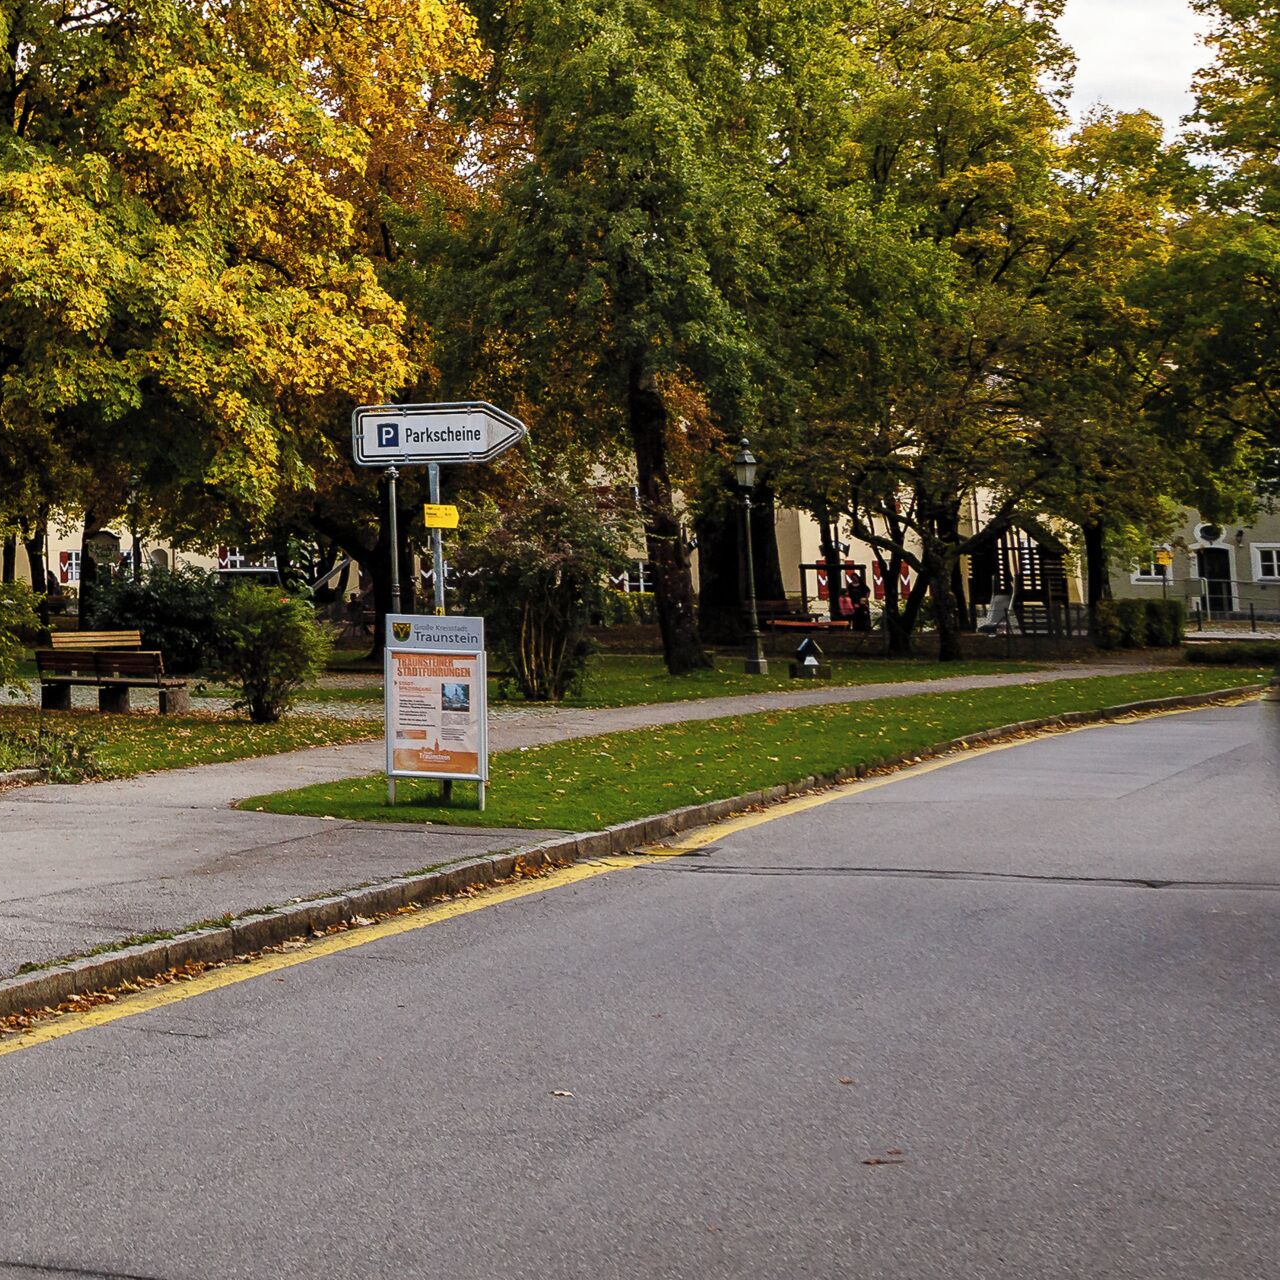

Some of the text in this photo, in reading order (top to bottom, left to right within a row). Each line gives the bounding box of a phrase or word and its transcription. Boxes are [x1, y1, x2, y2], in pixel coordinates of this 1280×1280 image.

[382, 426, 481, 445] P Parkscheine
[414, 631, 478, 644] Traunstein
[398, 658, 453, 667] TRAUNSTEINER
